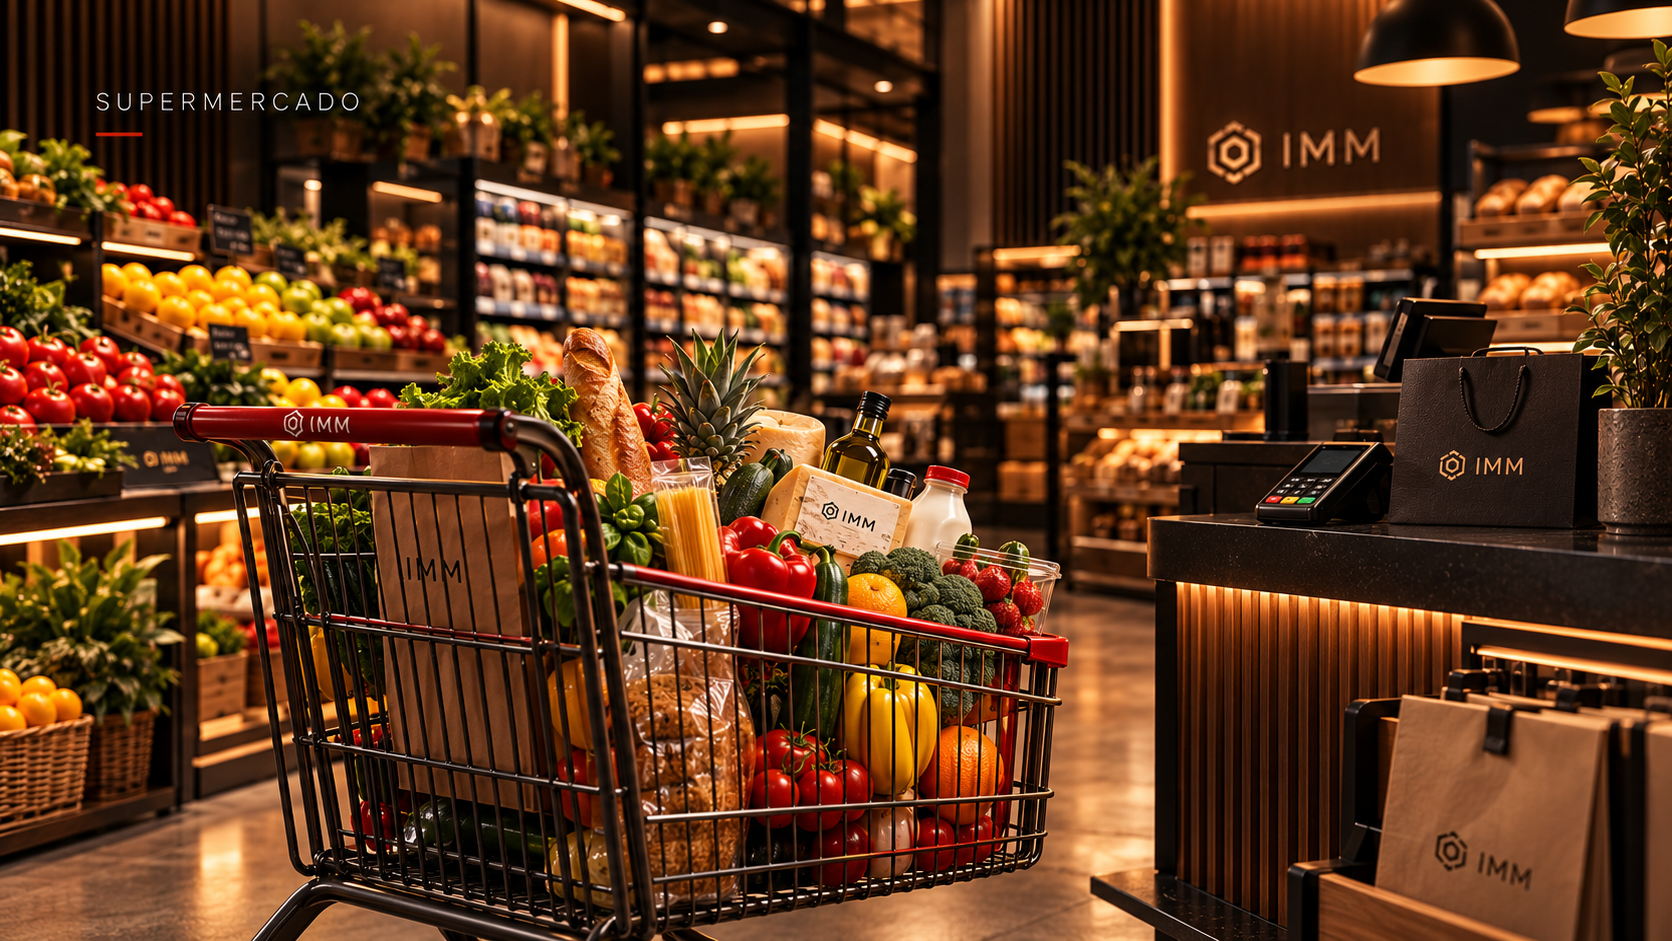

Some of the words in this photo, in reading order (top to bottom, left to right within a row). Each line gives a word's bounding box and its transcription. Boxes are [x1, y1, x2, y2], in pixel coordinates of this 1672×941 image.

[1283, 127, 1380, 169] IMM
[310, 416, 350, 433] IMM
[1476, 457, 1523, 475] IMM
[842, 510, 876, 532] IMM
[407, 557, 462, 583] IMM
[1478, 851, 1532, 892] IMM
